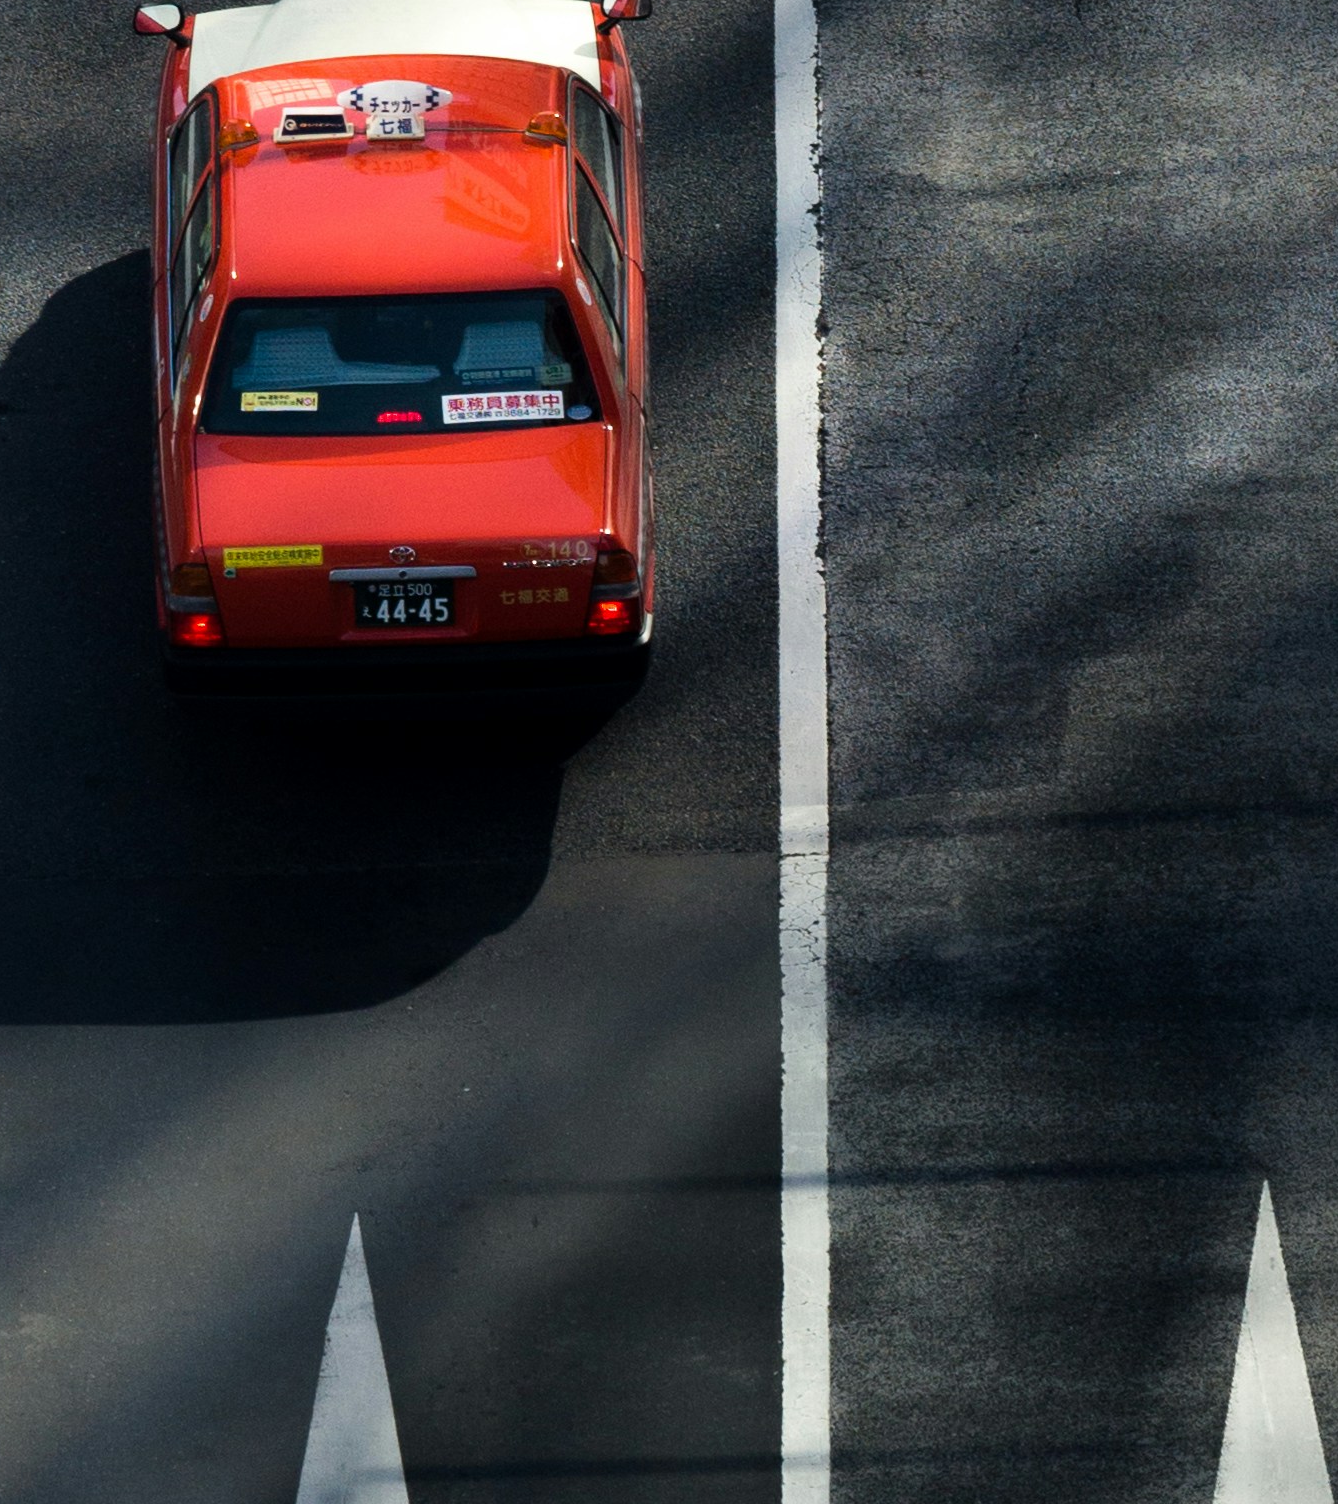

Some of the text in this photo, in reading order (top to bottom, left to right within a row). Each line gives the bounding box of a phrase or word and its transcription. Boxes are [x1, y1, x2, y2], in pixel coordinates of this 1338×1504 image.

[370, 96, 421, 113] チェッカー
[380, 118, 413, 135] 七福
[448, 394, 560, 413] 乗務員募集中
[548, 540, 588, 558] 140
[378, 583, 432, 597] 足立 500
[499, 587, 569, 605] 七福交通
[376, 598, 449, 623] 44-45
